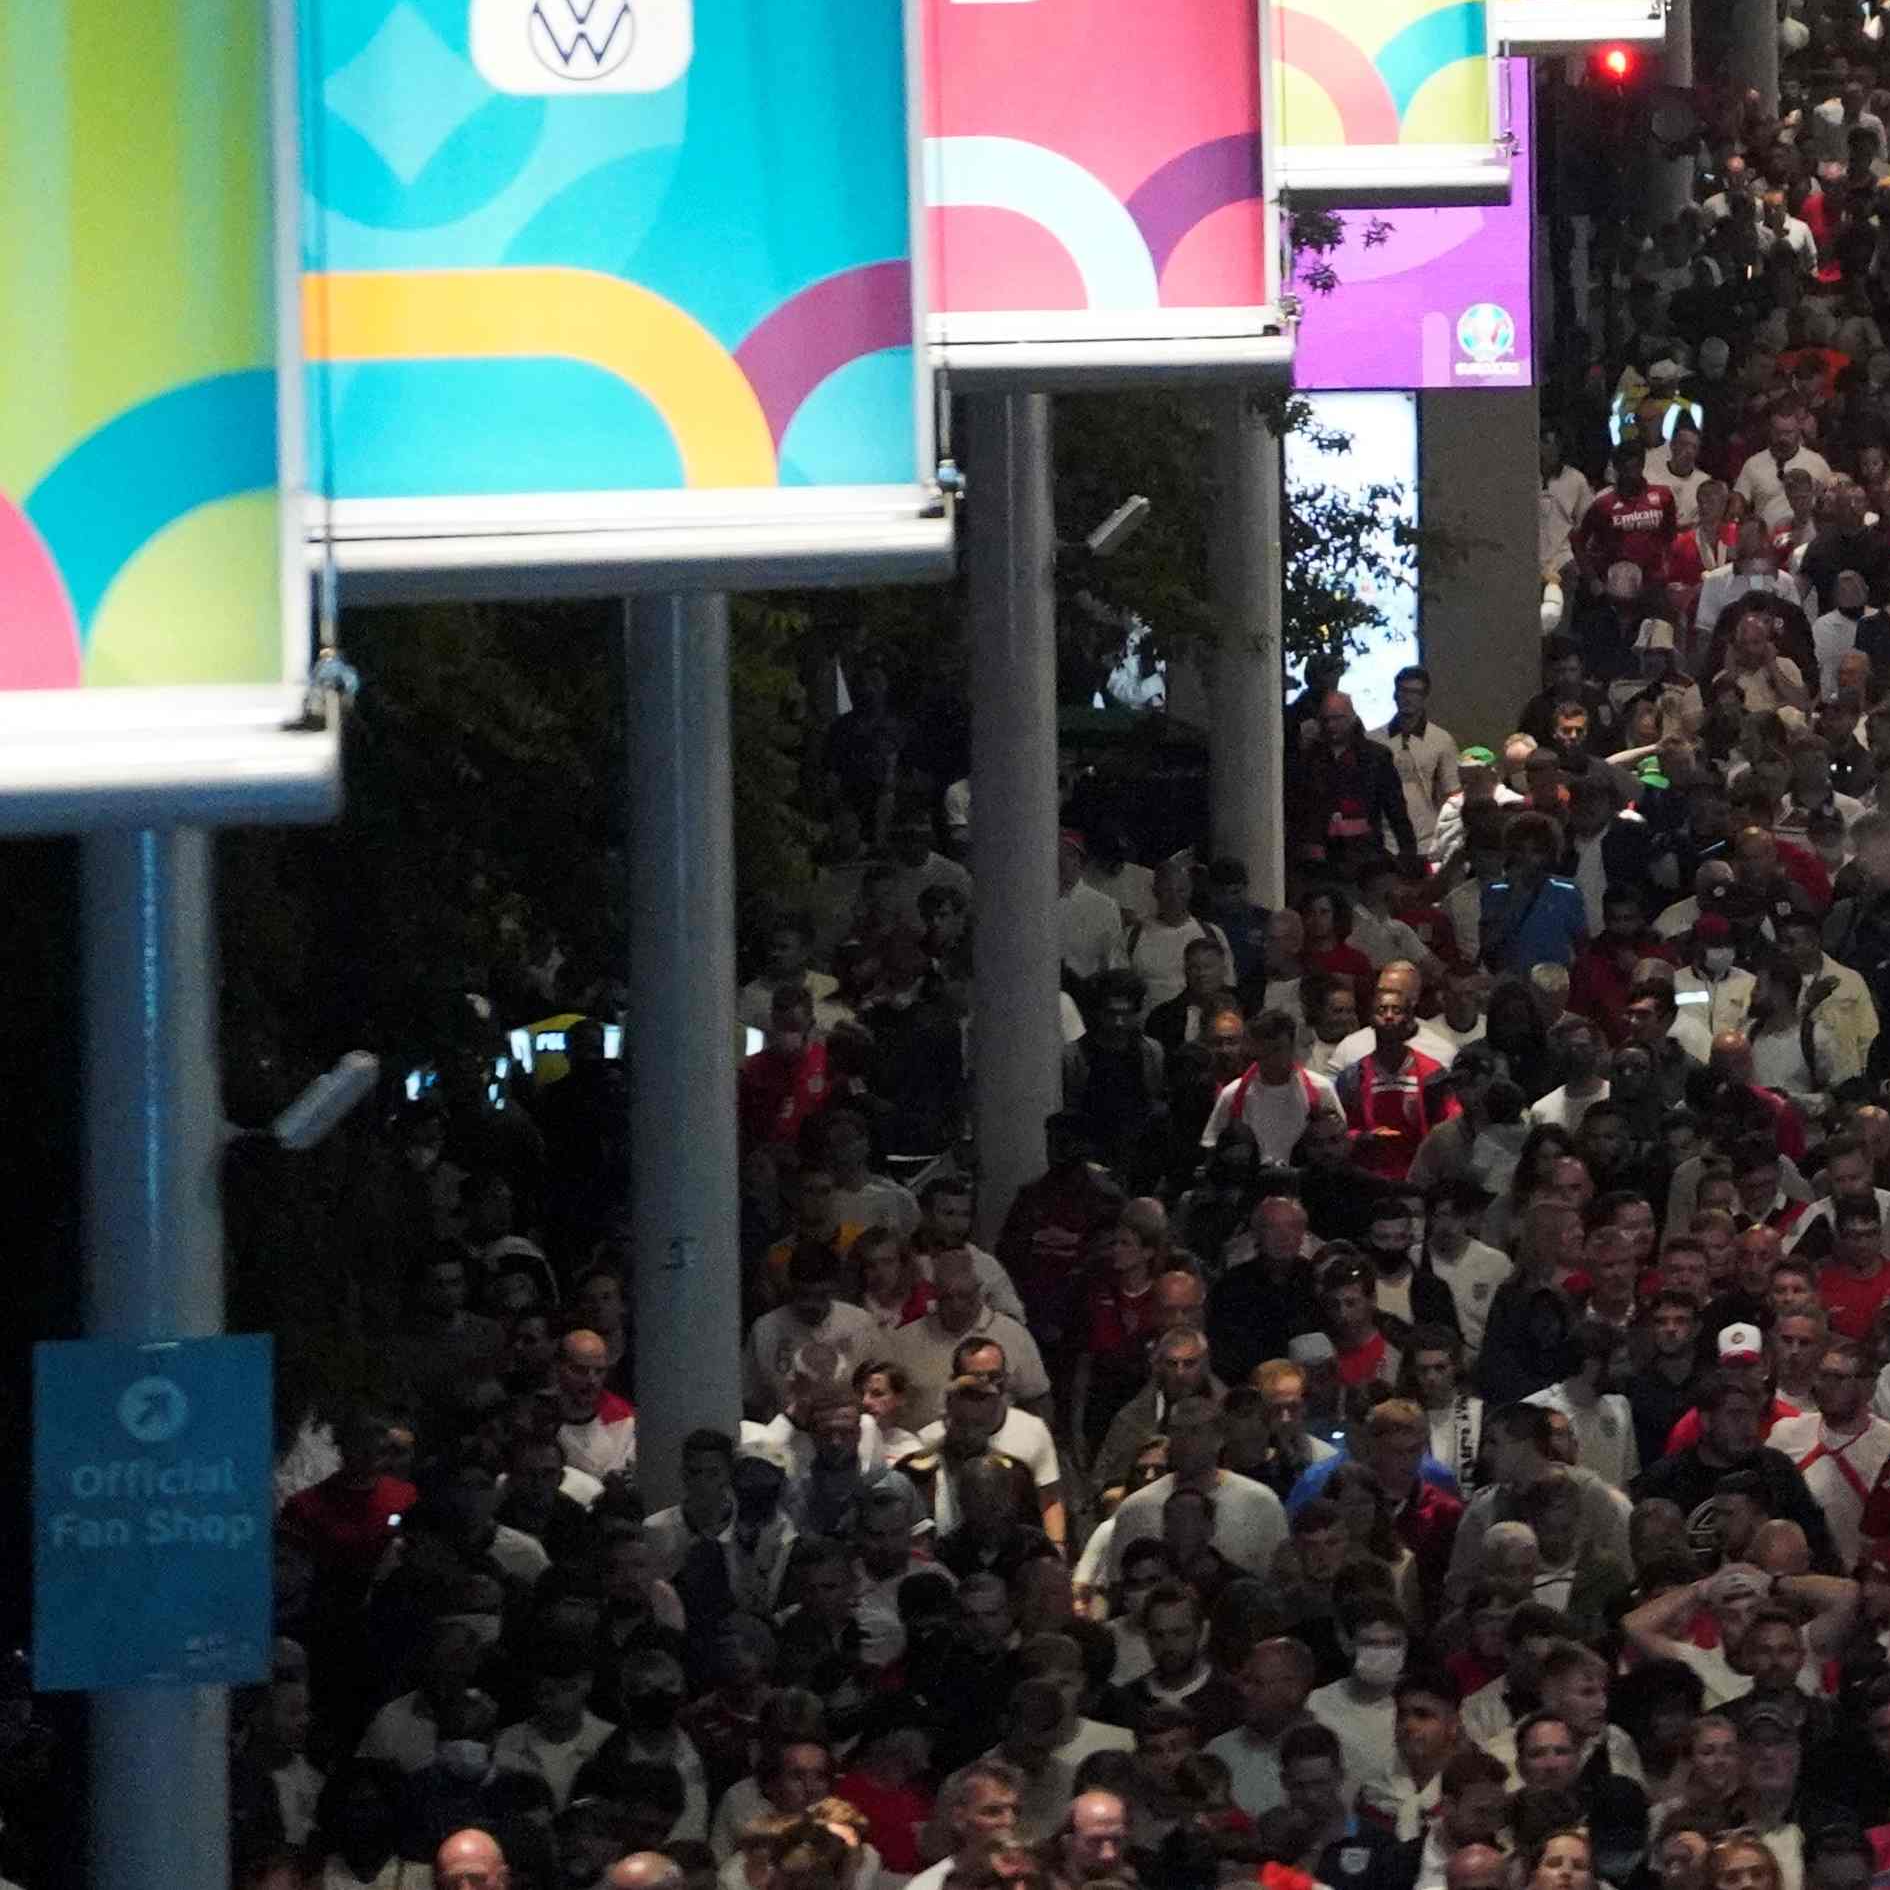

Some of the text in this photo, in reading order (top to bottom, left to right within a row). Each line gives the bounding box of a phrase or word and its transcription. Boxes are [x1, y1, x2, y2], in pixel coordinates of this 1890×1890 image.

[71, 1457, 235, 1498] Official
[50, 1510, 256, 1551] Fan Shop
